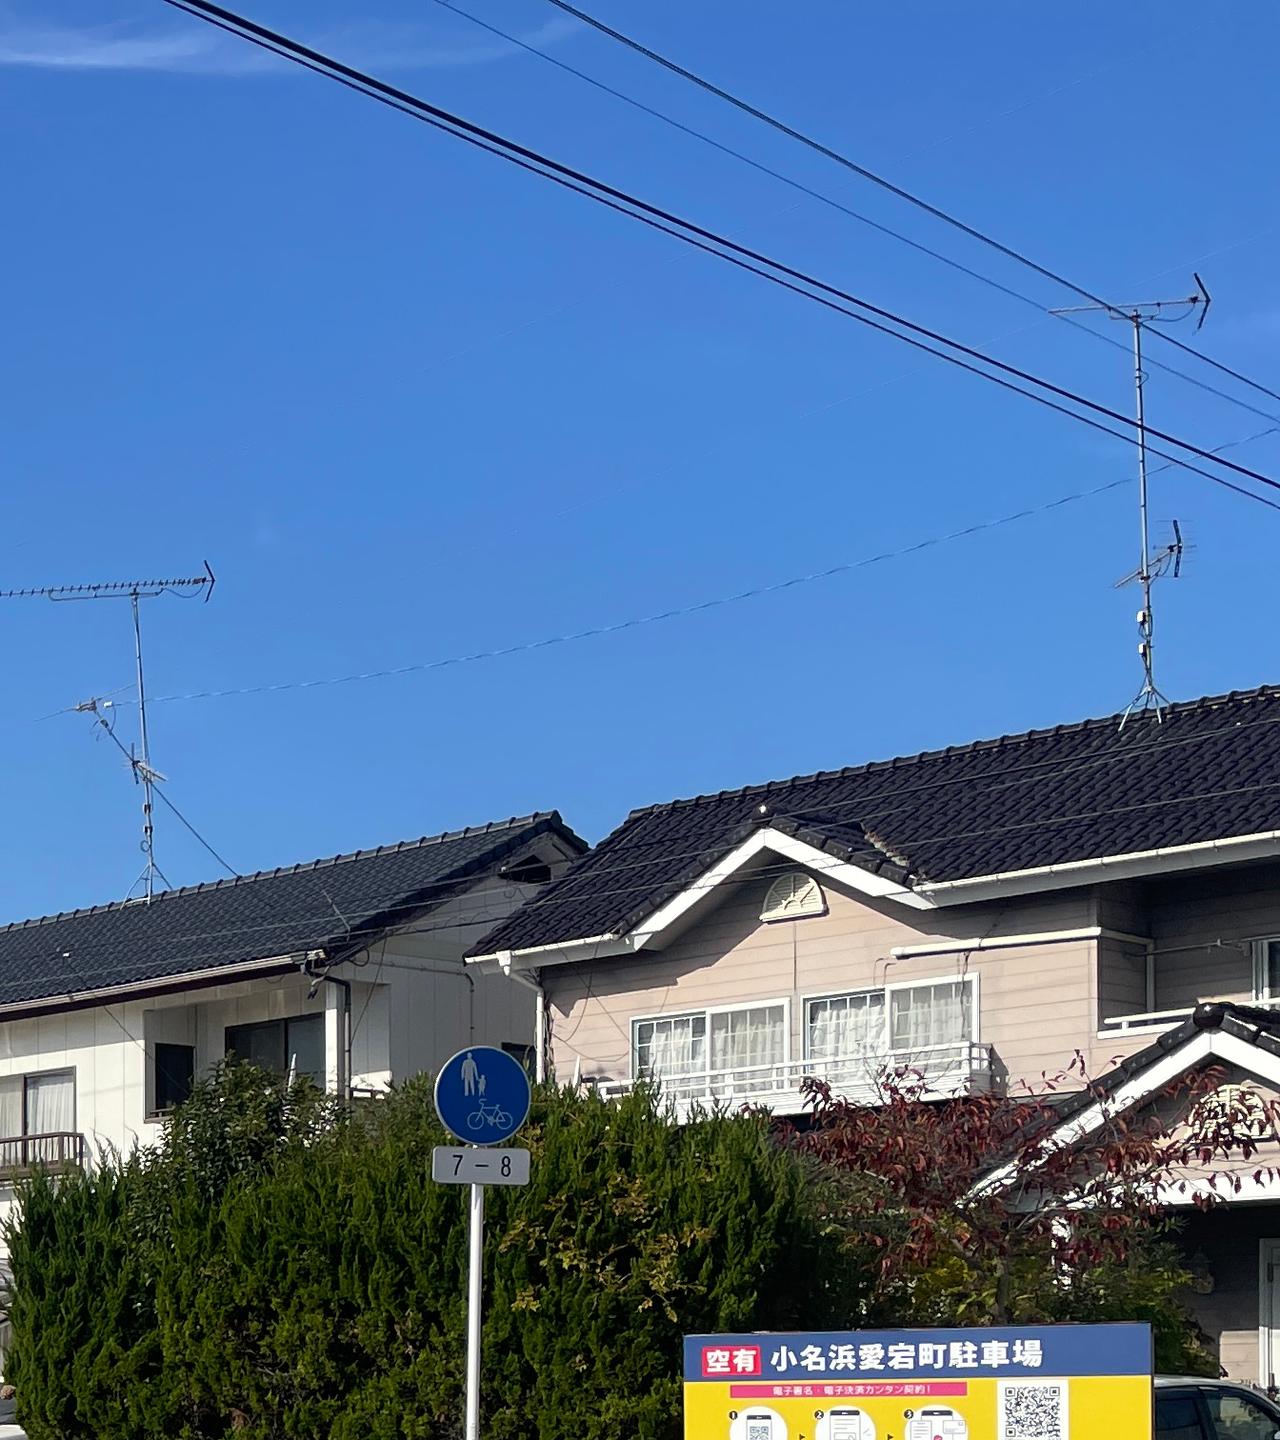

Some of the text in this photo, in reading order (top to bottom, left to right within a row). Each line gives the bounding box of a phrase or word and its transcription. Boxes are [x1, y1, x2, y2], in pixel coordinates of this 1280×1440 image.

[706, 1339, 1043, 1373] 空有 小名浜愛宕町駐車場
